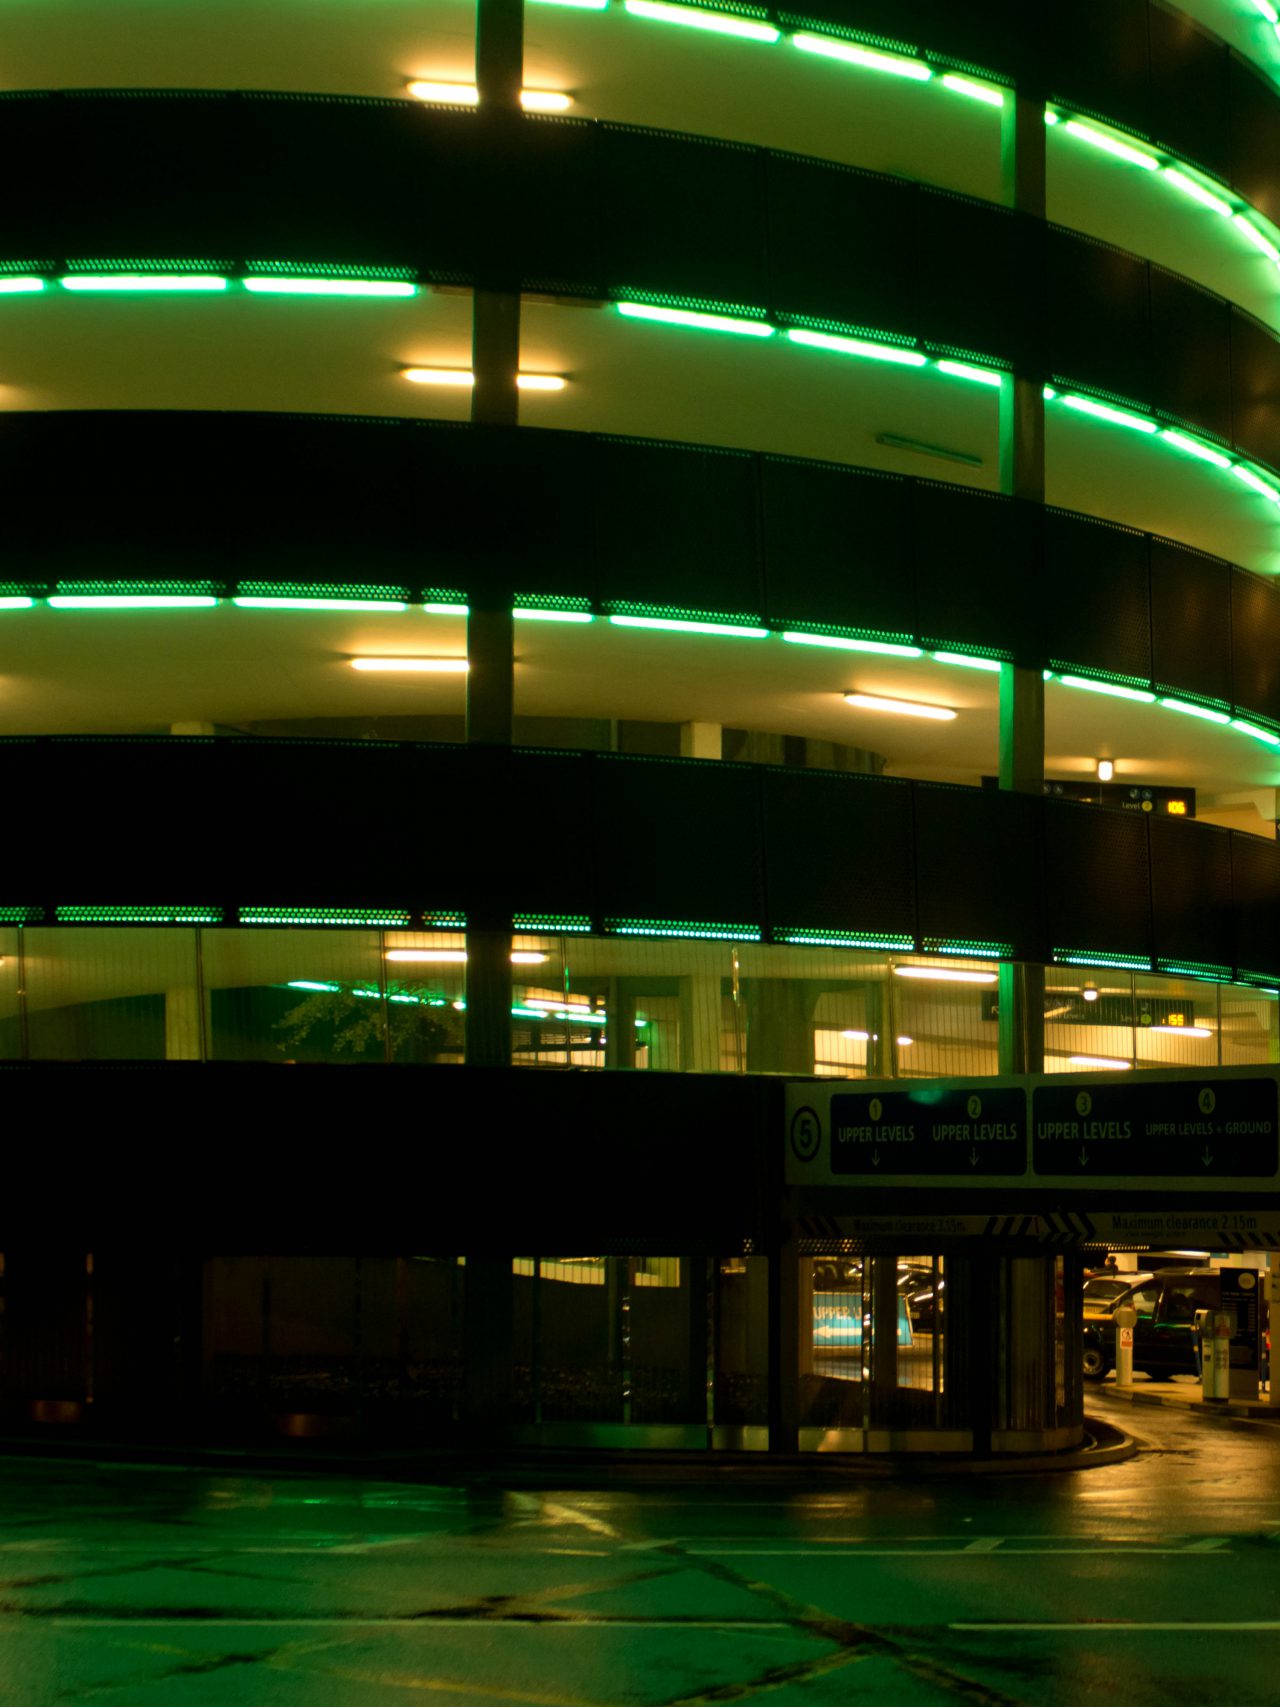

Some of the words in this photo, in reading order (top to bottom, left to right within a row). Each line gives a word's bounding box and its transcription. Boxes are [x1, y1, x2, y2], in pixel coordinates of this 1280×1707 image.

[971, 1099, 979, 1115] 2
[1079, 1095, 1087, 1112] 3
[1202, 1093, 1211, 1110] 4
[800, 1119, 812, 1148] 5
[838, 1125, 873, 1143] UPPER
[875, 1124, 915, 1142] LEVELS
[932, 1123, 969, 1141] UPPER
[974, 1123, 1017, 1141] LEVELS
[1038, 1122, 1080, 1140] UPPER
[1083, 1121, 1132, 1139] LEVELS
[1145, 1123, 1176, 1136] UPPER
[1178, 1122, 1213, 1135] LEVELS
[1225, 1121, 1272, 1134] GROUND
[1112, 1215, 1163, 1230] Maximum
[1167, 1215, 1218, 1230] clearance
[1222, 1215, 1257, 1230] 2.15m
[813, 1306, 849, 1320] UPPER
